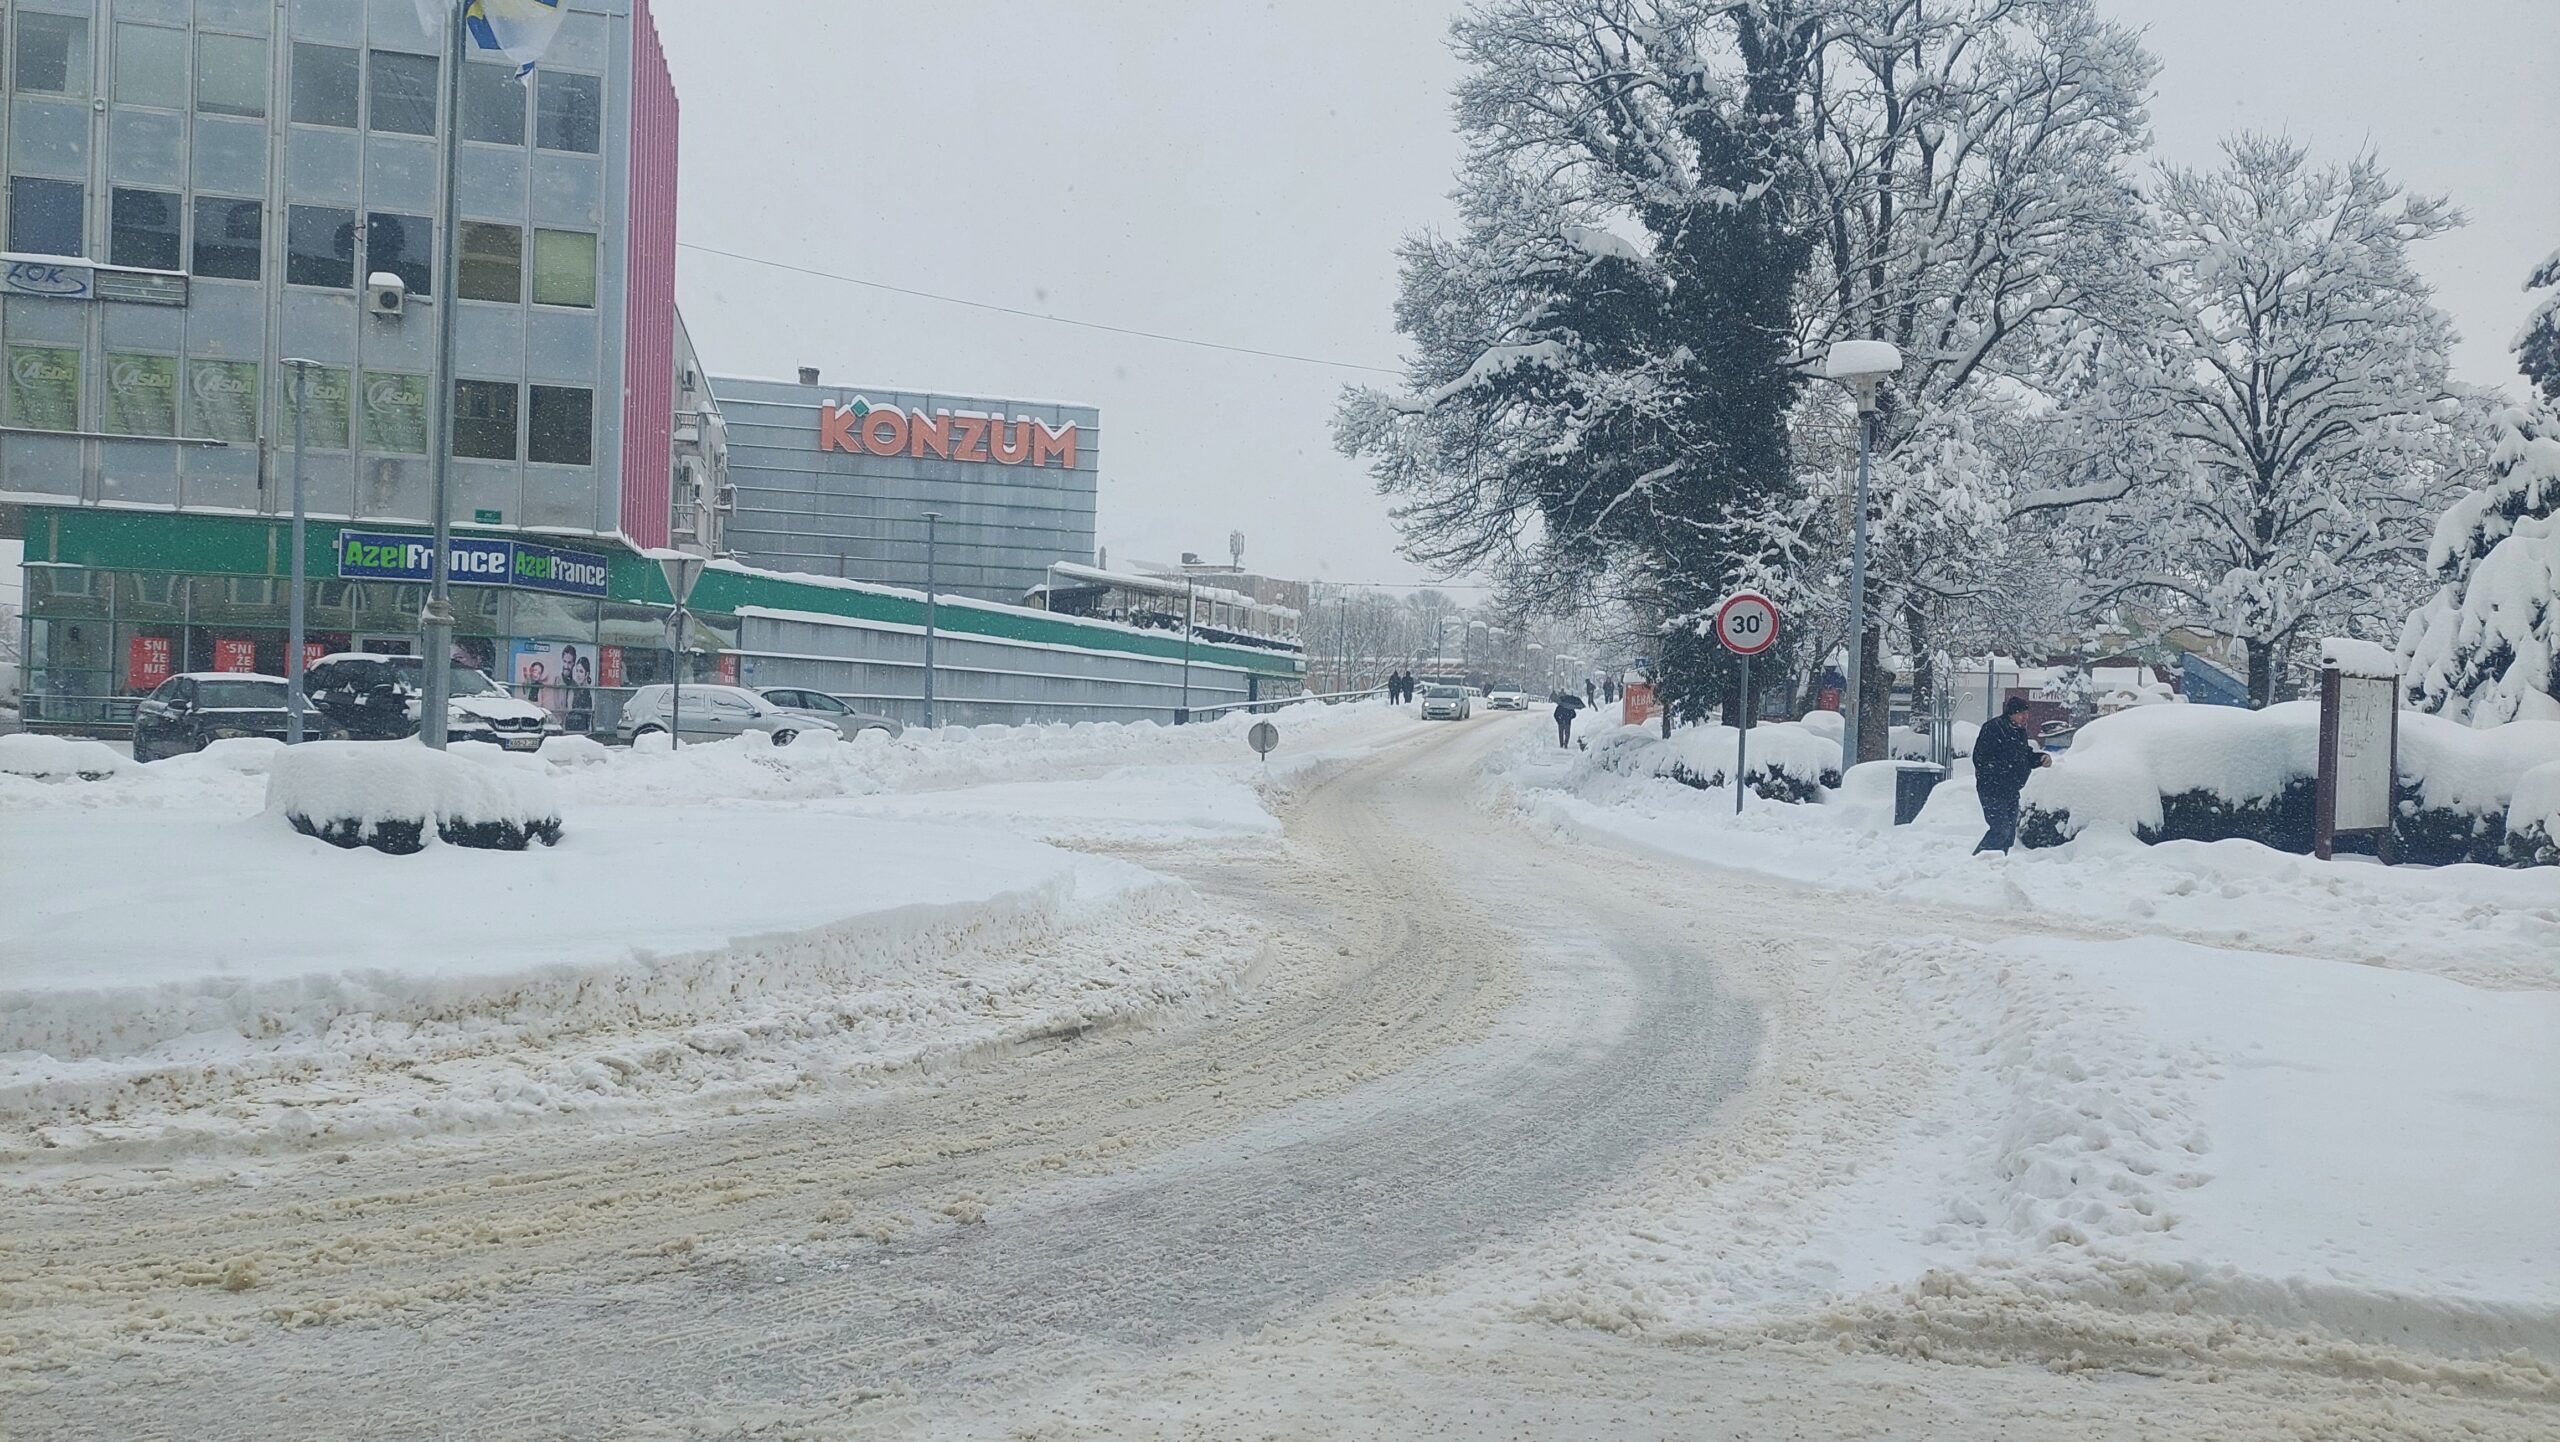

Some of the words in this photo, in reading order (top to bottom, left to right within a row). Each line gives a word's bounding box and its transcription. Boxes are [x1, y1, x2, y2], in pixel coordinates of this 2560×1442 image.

[22, 361, 74, 381] ASDA
[120, 369, 173, 388] ASDA
[202, 375, 254, 394] ASDA
[373, 388, 423, 406] ASDA
[821, 398, 1077, 469] KONZUM
[344, 540, 506, 574] AzelFrnce
[514, 551, 606, 586] AzelFrance
[143, 640, 167, 651] SNI
[229, 643, 252, 654] SNI
[152, 651, 166, 663] ŽE
[236, 654, 251, 665] ŽE
[143, 663, 166, 674] NJE
